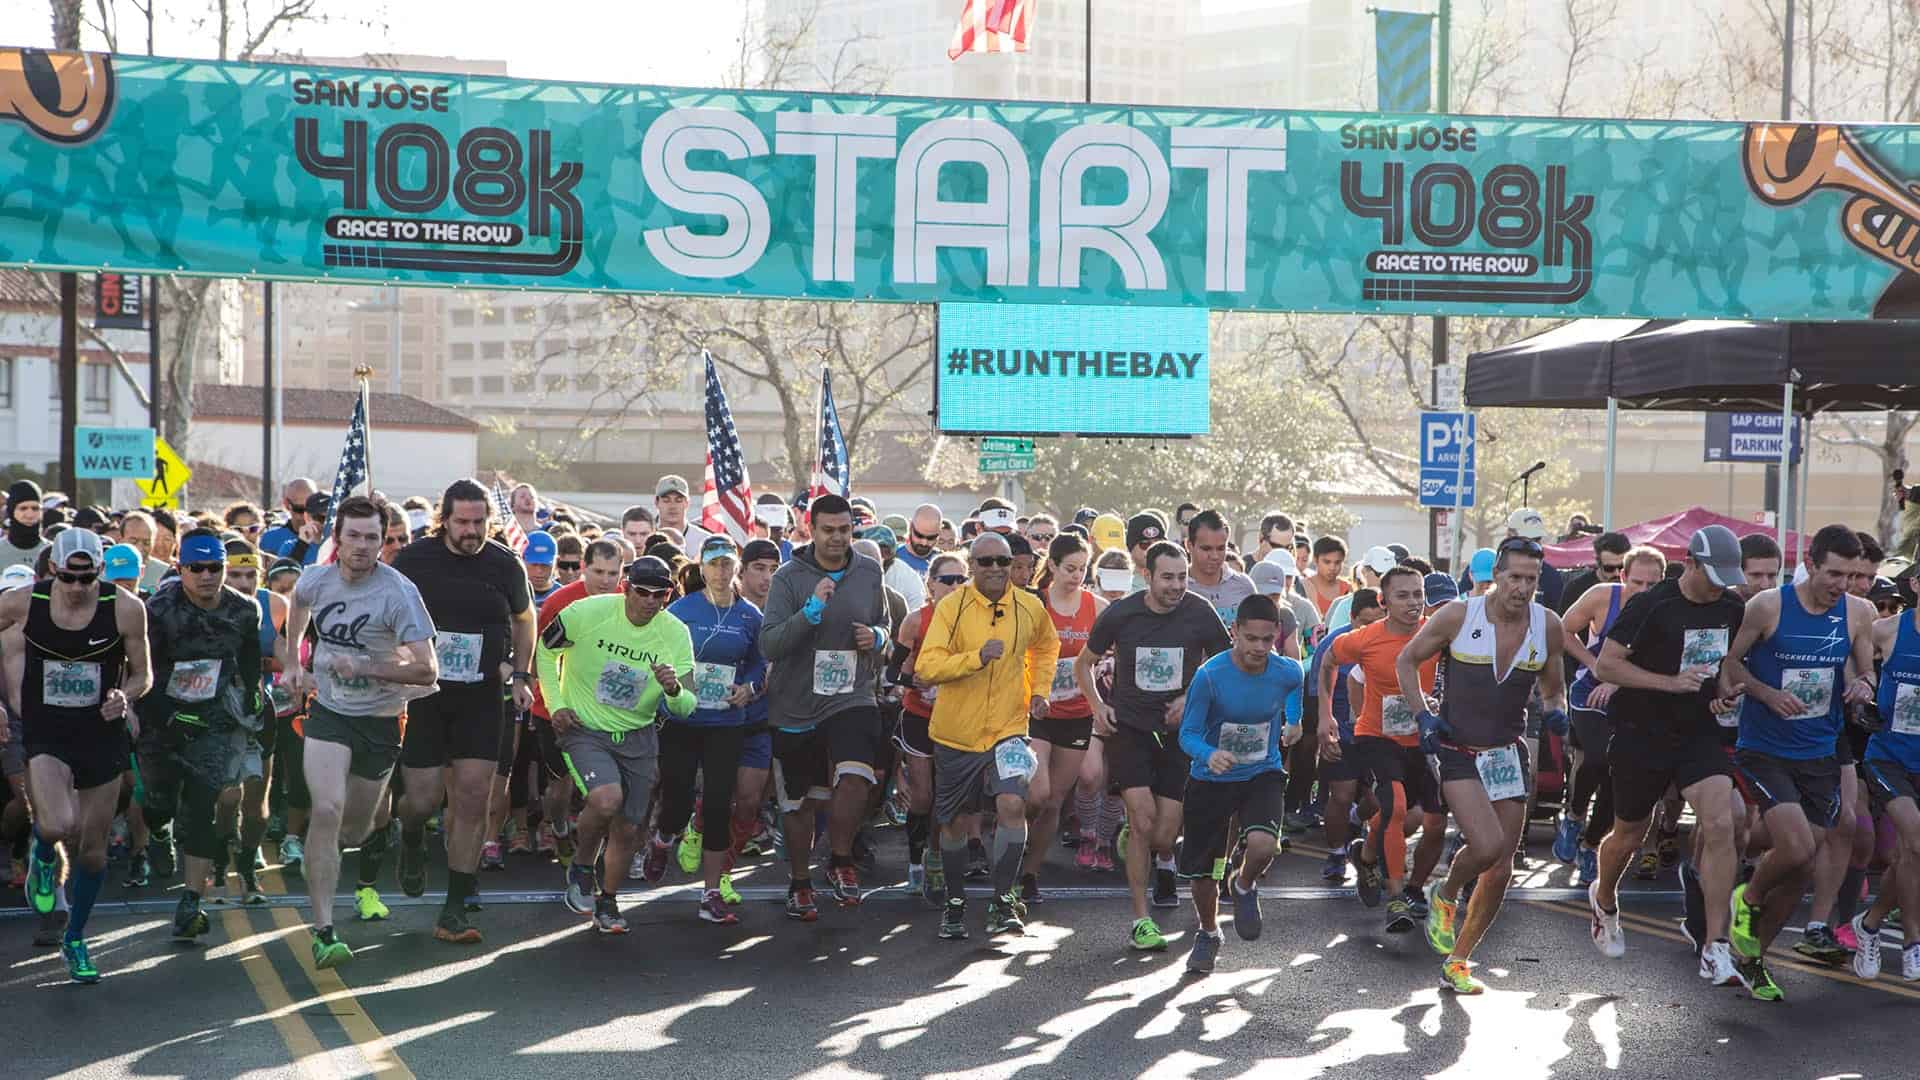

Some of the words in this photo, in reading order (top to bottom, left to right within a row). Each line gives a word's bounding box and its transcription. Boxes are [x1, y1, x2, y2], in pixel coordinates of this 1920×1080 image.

[293, 78, 360, 109] SAN
[366, 81, 449, 113] JOSE
[1340, 124, 1398, 150] SAN
[1403, 126, 1477, 152] JOSE
[641, 107, 1287, 293] START
[336, 219, 389, 240] RACE
[391, 221, 419, 241] TO
[421, 222, 459, 242] THE
[461, 223, 513, 244] ROW
[1375, 254, 1421, 272] RACE
[1422, 255, 1449, 272] TO
[1449, 256, 1484, 273] THE
[1485, 256, 1530, 274] ROW
[948, 347, 1204, 380] #RUNTHEBAY
[1731, 414, 1753, 427] SAP
[1754, 414, 1798, 429] CENTR
[81, 456, 134, 471] WAVE
[140, 456, 147, 471] 1
[315, 601, 371, 651] Cal
[614, 645, 659, 665] RUN
[1775, 651, 1818, 662] LOCKHEED
